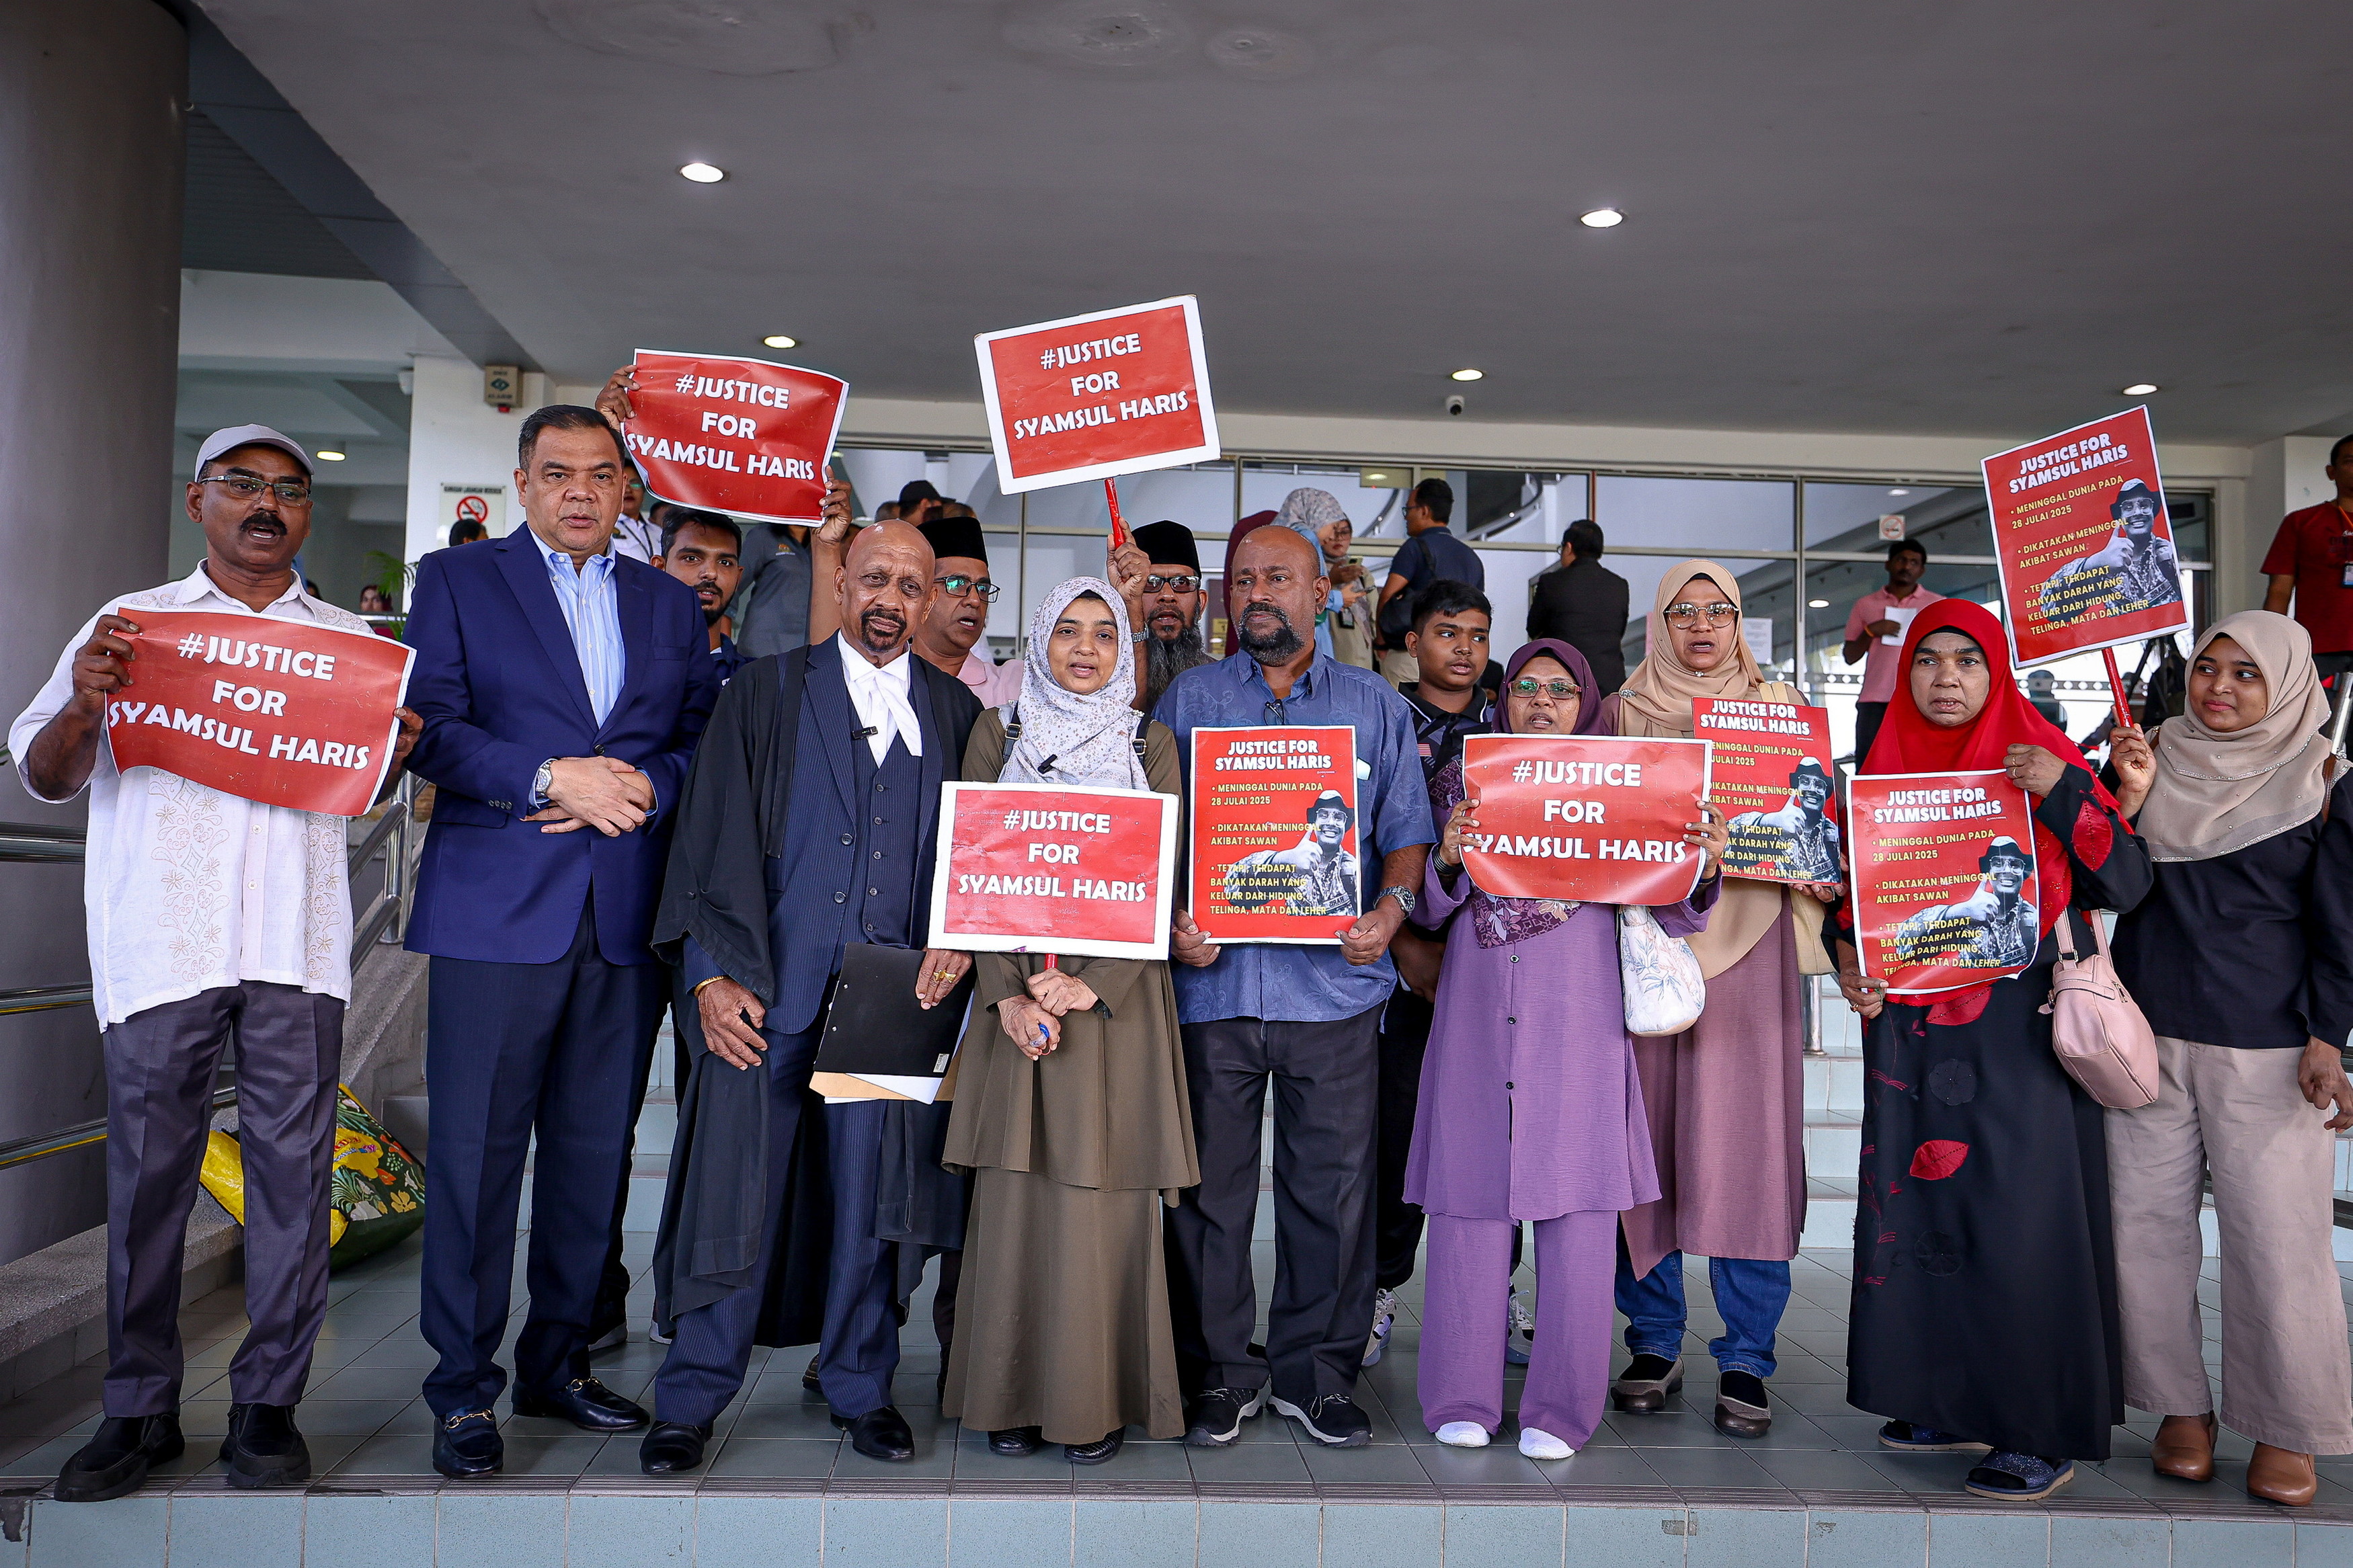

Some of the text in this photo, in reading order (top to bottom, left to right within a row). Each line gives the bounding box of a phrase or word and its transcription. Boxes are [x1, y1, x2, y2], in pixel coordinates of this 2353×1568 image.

[1040, 333, 1142, 370] #JUSTICE
[675, 374, 790, 409] #JUSTICE
[1070, 370, 1120, 397] FOR
[1014, 390, 1189, 440] SYAMSUL HARIS
[701, 411, 757, 440] FOR
[627, 432, 814, 480] SYAMSUL HARIS
[2020, 433, 2112, 476] JUSTICE FOR
[2009, 444, 2128, 494] SYAMSUL HARIS
[2016, 475, 2124, 515] MENINGGAL DUNIA PADA
[2011, 505, 2072, 530] 28 JULAI 2025
[2023, 518, 2128, 554] DIKATAKAN MENINGGAL
[2019, 543, 2086, 569] AKIBAT SAWAN
[2030, 565, 2110, 594] TETAPI, TERDAPAT
[2026, 577, 2123, 609] BANYAK DARAH YANG
[2028, 591, 2124, 622] KELUAR DARI HIDUNG,
[2030, 599, 2149, 636] TELINGA, MATA DAN LEHER
[177, 632, 335, 681] #JUSTICE
[212, 679, 287, 716] FOR
[1711, 700, 1798, 720] JUSTICE FOR
[1700, 714, 1811, 736] SYAMSUL HARIS
[109, 701, 370, 770] SYAMSUL HARIS
[1228, 740, 1318, 755] JUSTICE FOR
[1712, 741, 1803, 756] ENINGGAL DUNIA PADA
[1215, 755, 1332, 772] SYAMSUL HARIS
[1735, 757, 1755, 766] 2025
[1512, 760, 1642, 787] #JUSTICE
[1218, 782, 1323, 792] MENINGGAL DUNIA PADA
[1756, 785, 1804, 796] MENINGGAL
[1887, 788, 1986, 806] JUSTICE FOR
[1211, 796, 1271, 806] 28 JULAI 2025
[1708, 796, 1764, 807] KIBAT SAWAN
[1002, 809, 1111, 833] #JUSTICE
[1544, 799, 1605, 824] FOR
[1874, 800, 2001, 823] SYAMSUL HARIS
[1217, 823, 1322, 831] DIKATAKAN MENINGGAL
[1741, 825, 1783, 836] TERDAPAT
[1211, 837, 1277, 845] AKIBAT SAWAN
[1739, 839, 1769, 848] DARAH
[1769, 841, 1793, 850] YANG
[1879, 829, 1994, 847] MENINGGAL DUNIA PADA
[1027, 843, 1080, 865] FOR
[1598, 839, 1687, 864] HARIS
[1737, 852, 1757, 861] DARI
[1758, 854, 1794, 864] HIDUNG,
[1872, 850, 1938, 862] 28 JULAI 2025
[1217, 864, 1296, 874] TETAPI, TERDAPAT
[1743, 866, 1766, 875] MATA
[1769, 868, 1787, 877] DAN
[1789, 870, 1812, 879] LEHER
[958, 874, 1147, 903] SYAMSUL HARIS
[1210, 878, 1306, 886] BANYAK DARAH YANG
[1882, 873, 1997, 890] DIKATAKAN MENINGGAL
[1210, 892, 1306, 901] KELUAR DARI HIDUNG,
[1876, 891, 1948, 904] AKIBAT SAWAN
[1210, 906, 1326, 915] TELINGA, MATA DAN LEHER
[1885, 917, 1970, 932] TETAPI, TERDAPAT
[1880, 930, 1982, 948] BANYAK DARAH YANG
[1882, 944, 1981, 962] KELUAR DARI HIDUNG,
[1884, 957, 2001, 976] TELINGA, MATA DAN LEHER
